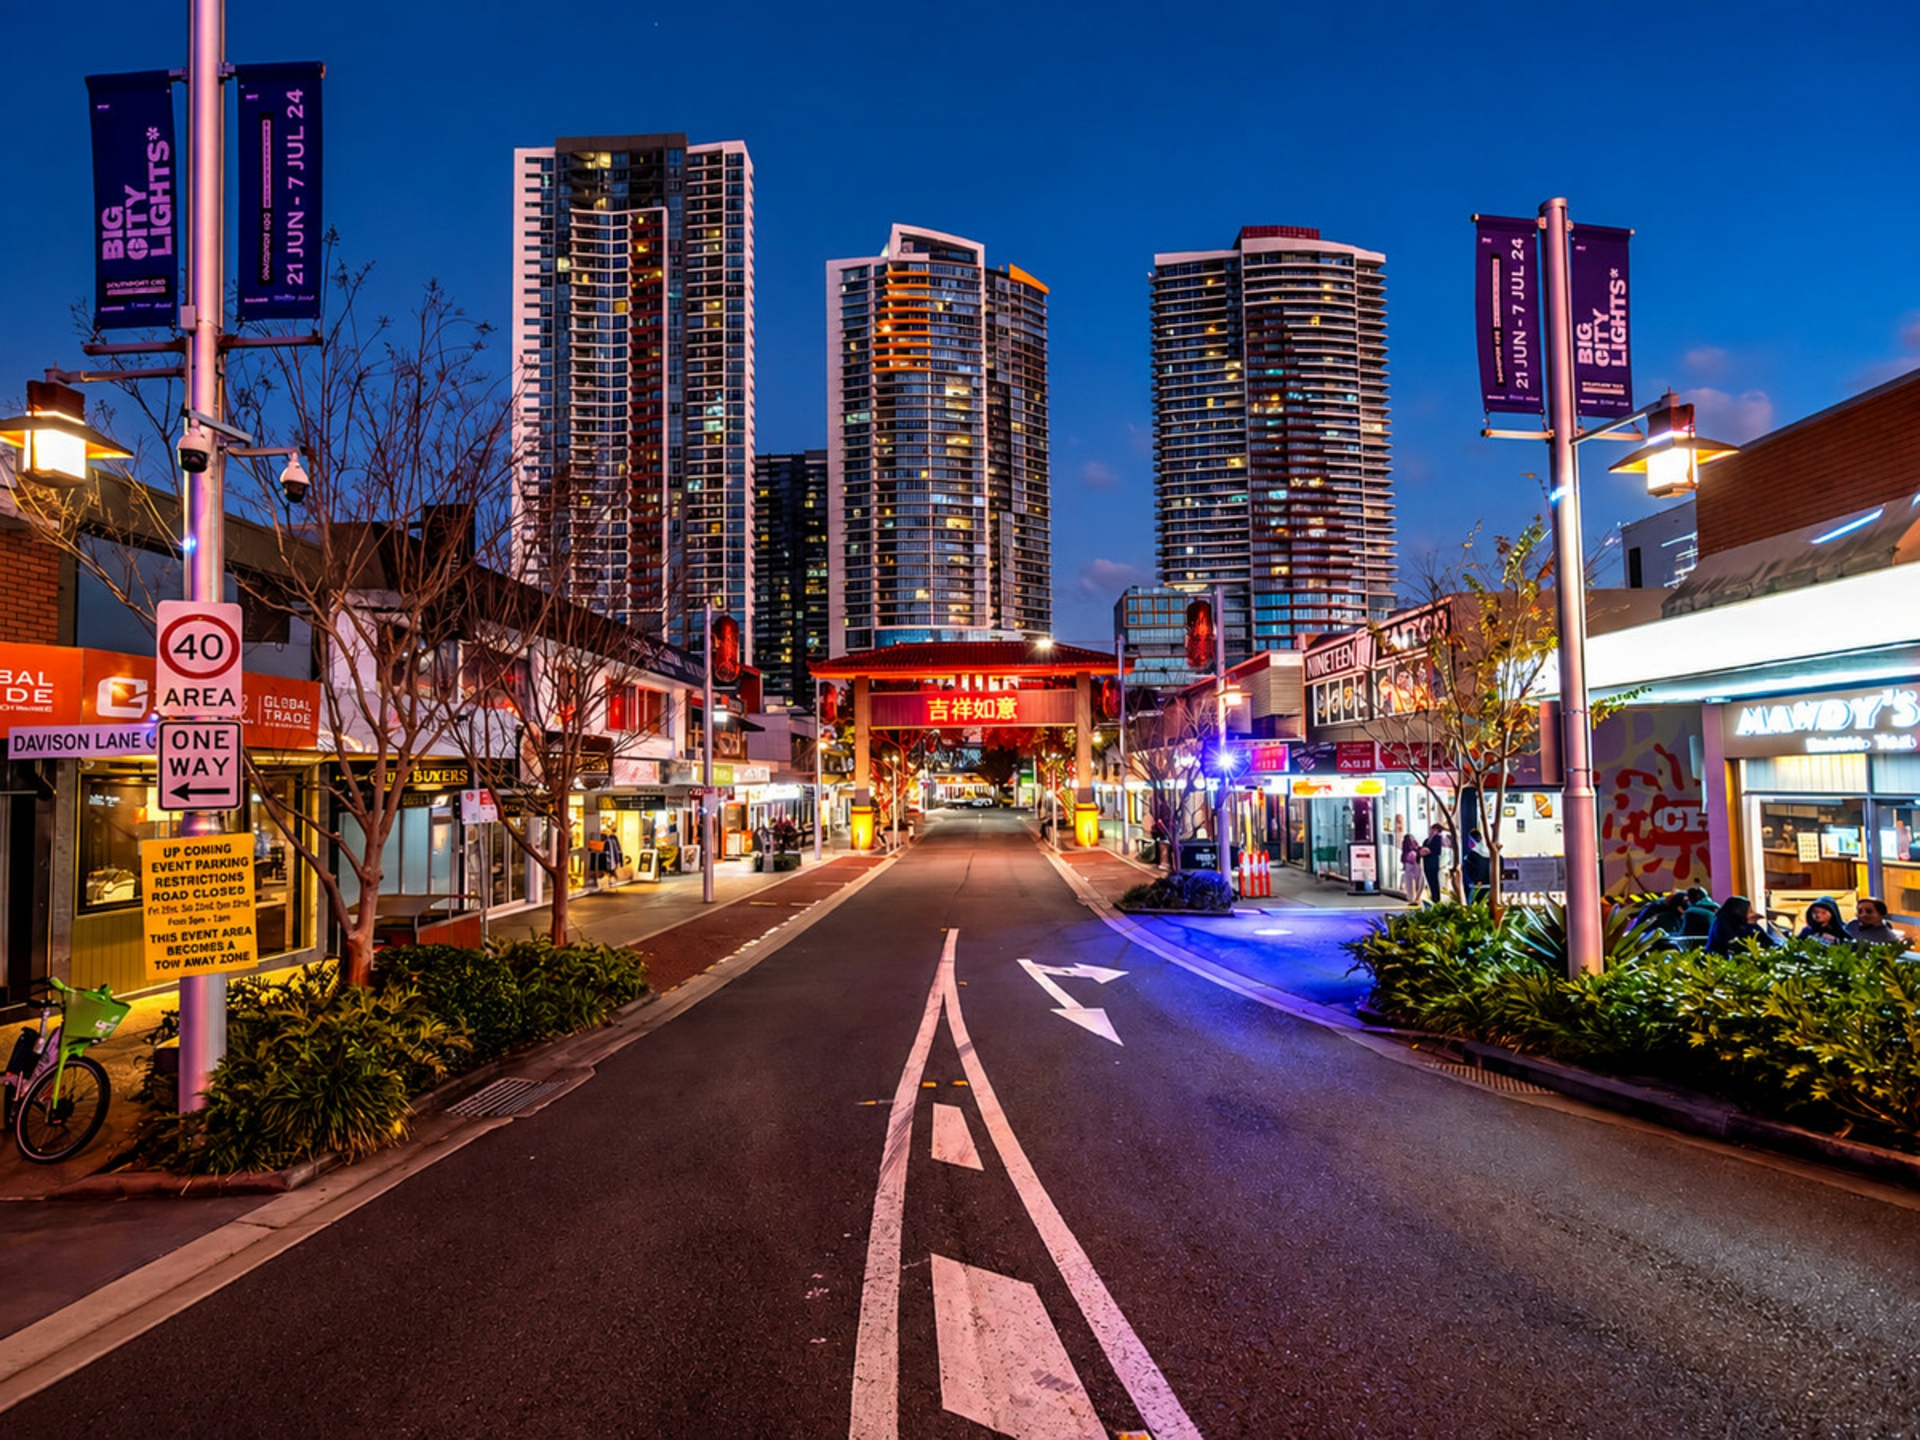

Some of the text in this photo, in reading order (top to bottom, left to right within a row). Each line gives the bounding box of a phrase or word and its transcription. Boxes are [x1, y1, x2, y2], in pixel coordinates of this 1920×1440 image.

[286, 88, 304, 119] 24
[286, 126, 305, 170] JUL
[287, 176, 305, 190] 7
[124, 184, 148, 261] CITY
[102, 206, 125, 260] BIG
[286, 211, 305, 257] JUN
[1511, 237, 1525, 260] 24
[286, 263, 304, 286] 21
[1511, 265, 1526, 301] JUL
[1511, 304, 1526, 315] 7
[1576, 323, 1594, 365] BIG
[1593, 308, 1611, 367] CITY
[1513, 330, 1528, 368] JUN
[1515, 371, 1529, 389] 21
[172, 633, 224, 661] 40
[1306, 641, 1356, 679] NINETEEN
[163, 688, 236, 707] AREA
[264, 695, 312, 712] GLOBAL
[264, 709, 312, 725] TRADE
[927, 696, 1018, 721] 吉祥如意
[1735, 689, 1920, 736] MANDY'S
[14, 733, 90, 752] DAVISON
[95, 732, 142, 750] LANE
[172, 730, 230, 750] ONE
[169, 757, 230, 777] WAY
[163, 843, 232, 858] UP COMING
[151, 856, 249, 873] EVENT PARKING
[155, 872, 244, 888] RESTRICTIONS
[151, 886, 245, 902] ROAD CLOSED
[150, 925, 252, 944] THIS EVENT AREA
[166, 940, 236, 956] BECOMES A
[154, 951, 250, 970] TOW AWAY ZONE
